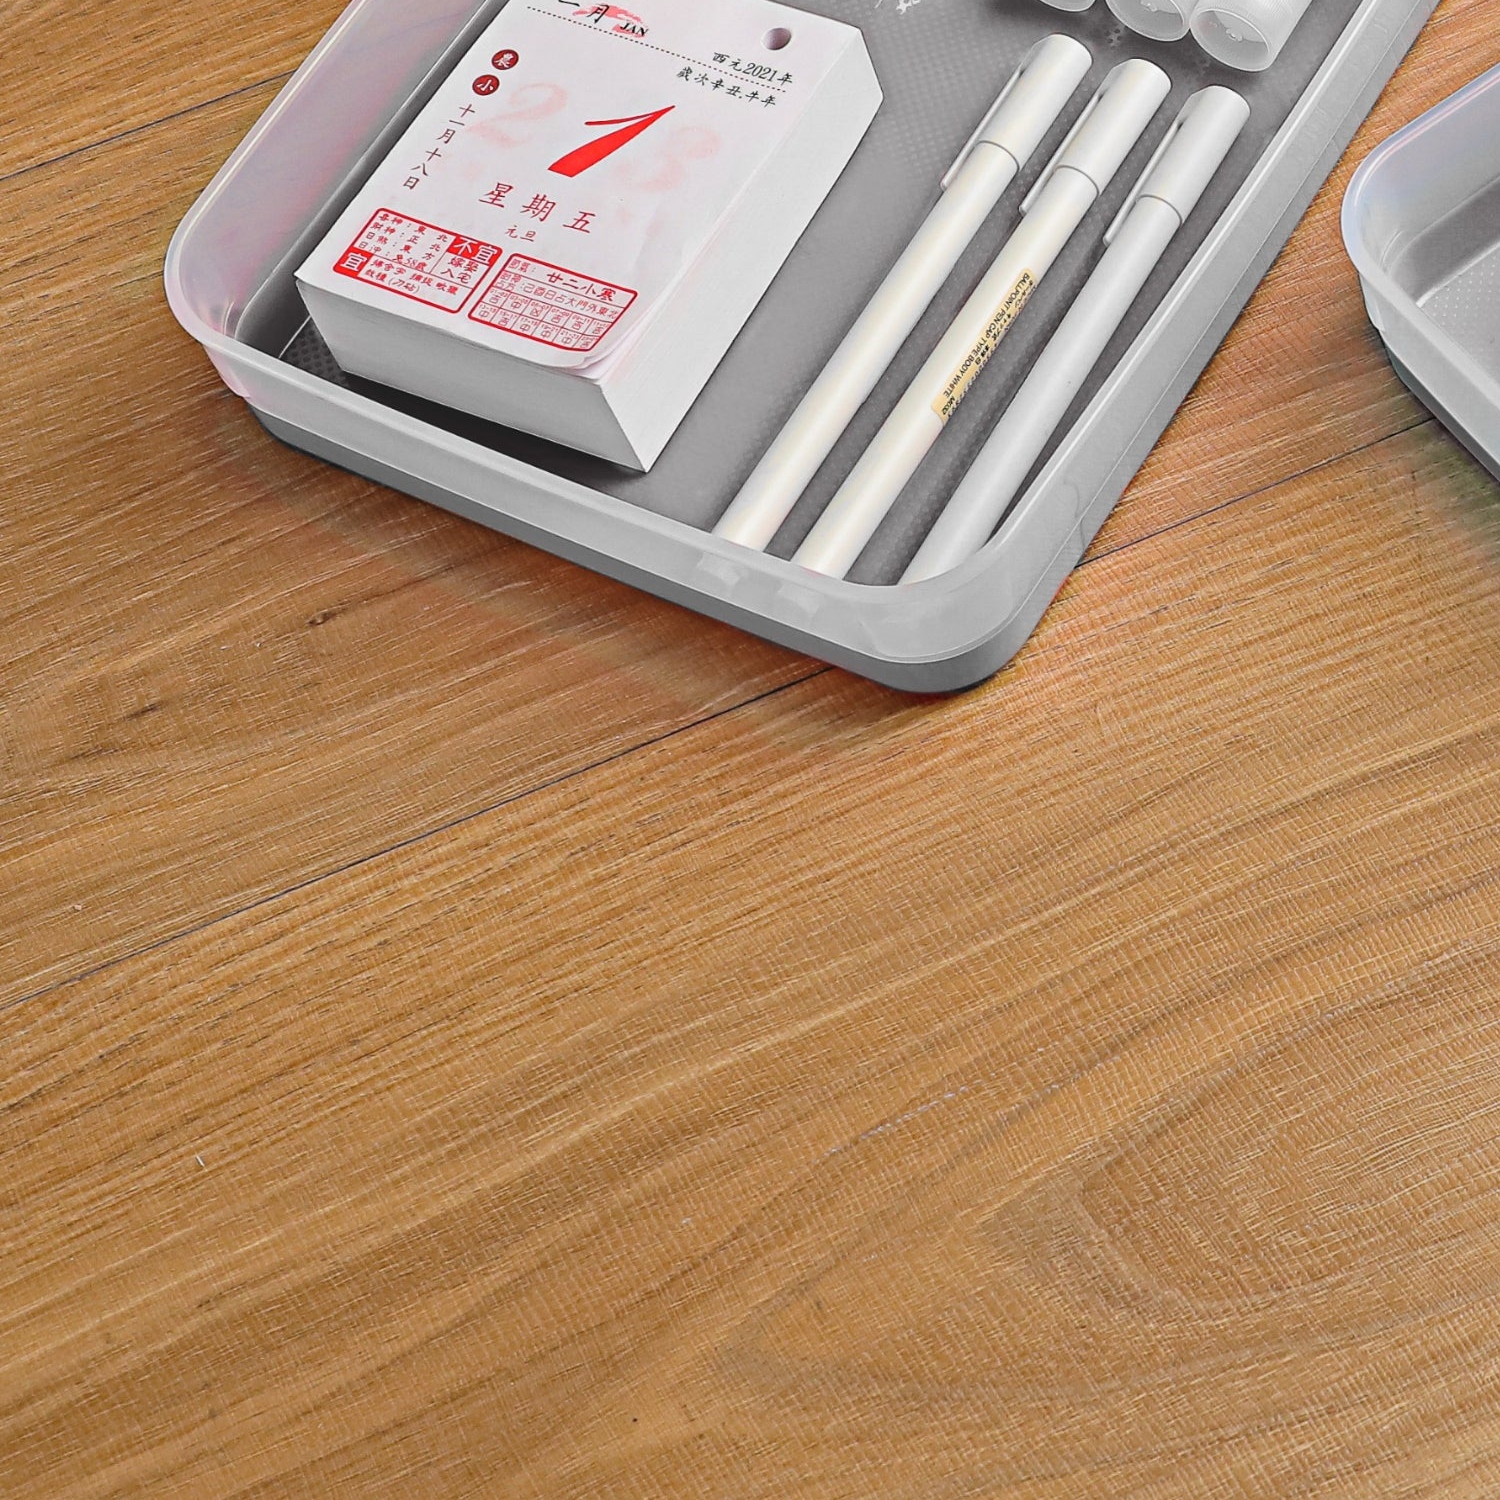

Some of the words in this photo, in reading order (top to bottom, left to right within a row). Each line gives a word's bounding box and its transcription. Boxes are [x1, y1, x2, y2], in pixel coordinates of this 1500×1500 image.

[618, 21, 650, 38] JAN
[711, 51, 794, 86] 西元2021年
[402, 103, 476, 191] 十一月十八日
[547, 104, 676, 178] 1
[478, 182, 597, 234] 星期五
[504, 224, 538, 243] 元旦
[339, 250, 369, 272] 宜
[449, 236, 499, 265] 不宜
[438, 266, 473, 284] 入宅
[542, 269, 619, 302] 廿二小寒
[1004, 272, 1030, 310] BALLPOINT
[995, 309, 1007, 323] PEN
[985, 323, 997, 339] CAP
[973, 336, 988, 358] TYPE
[961, 353, 975, 377] BODY
[943, 374, 962, 399] WHITE
